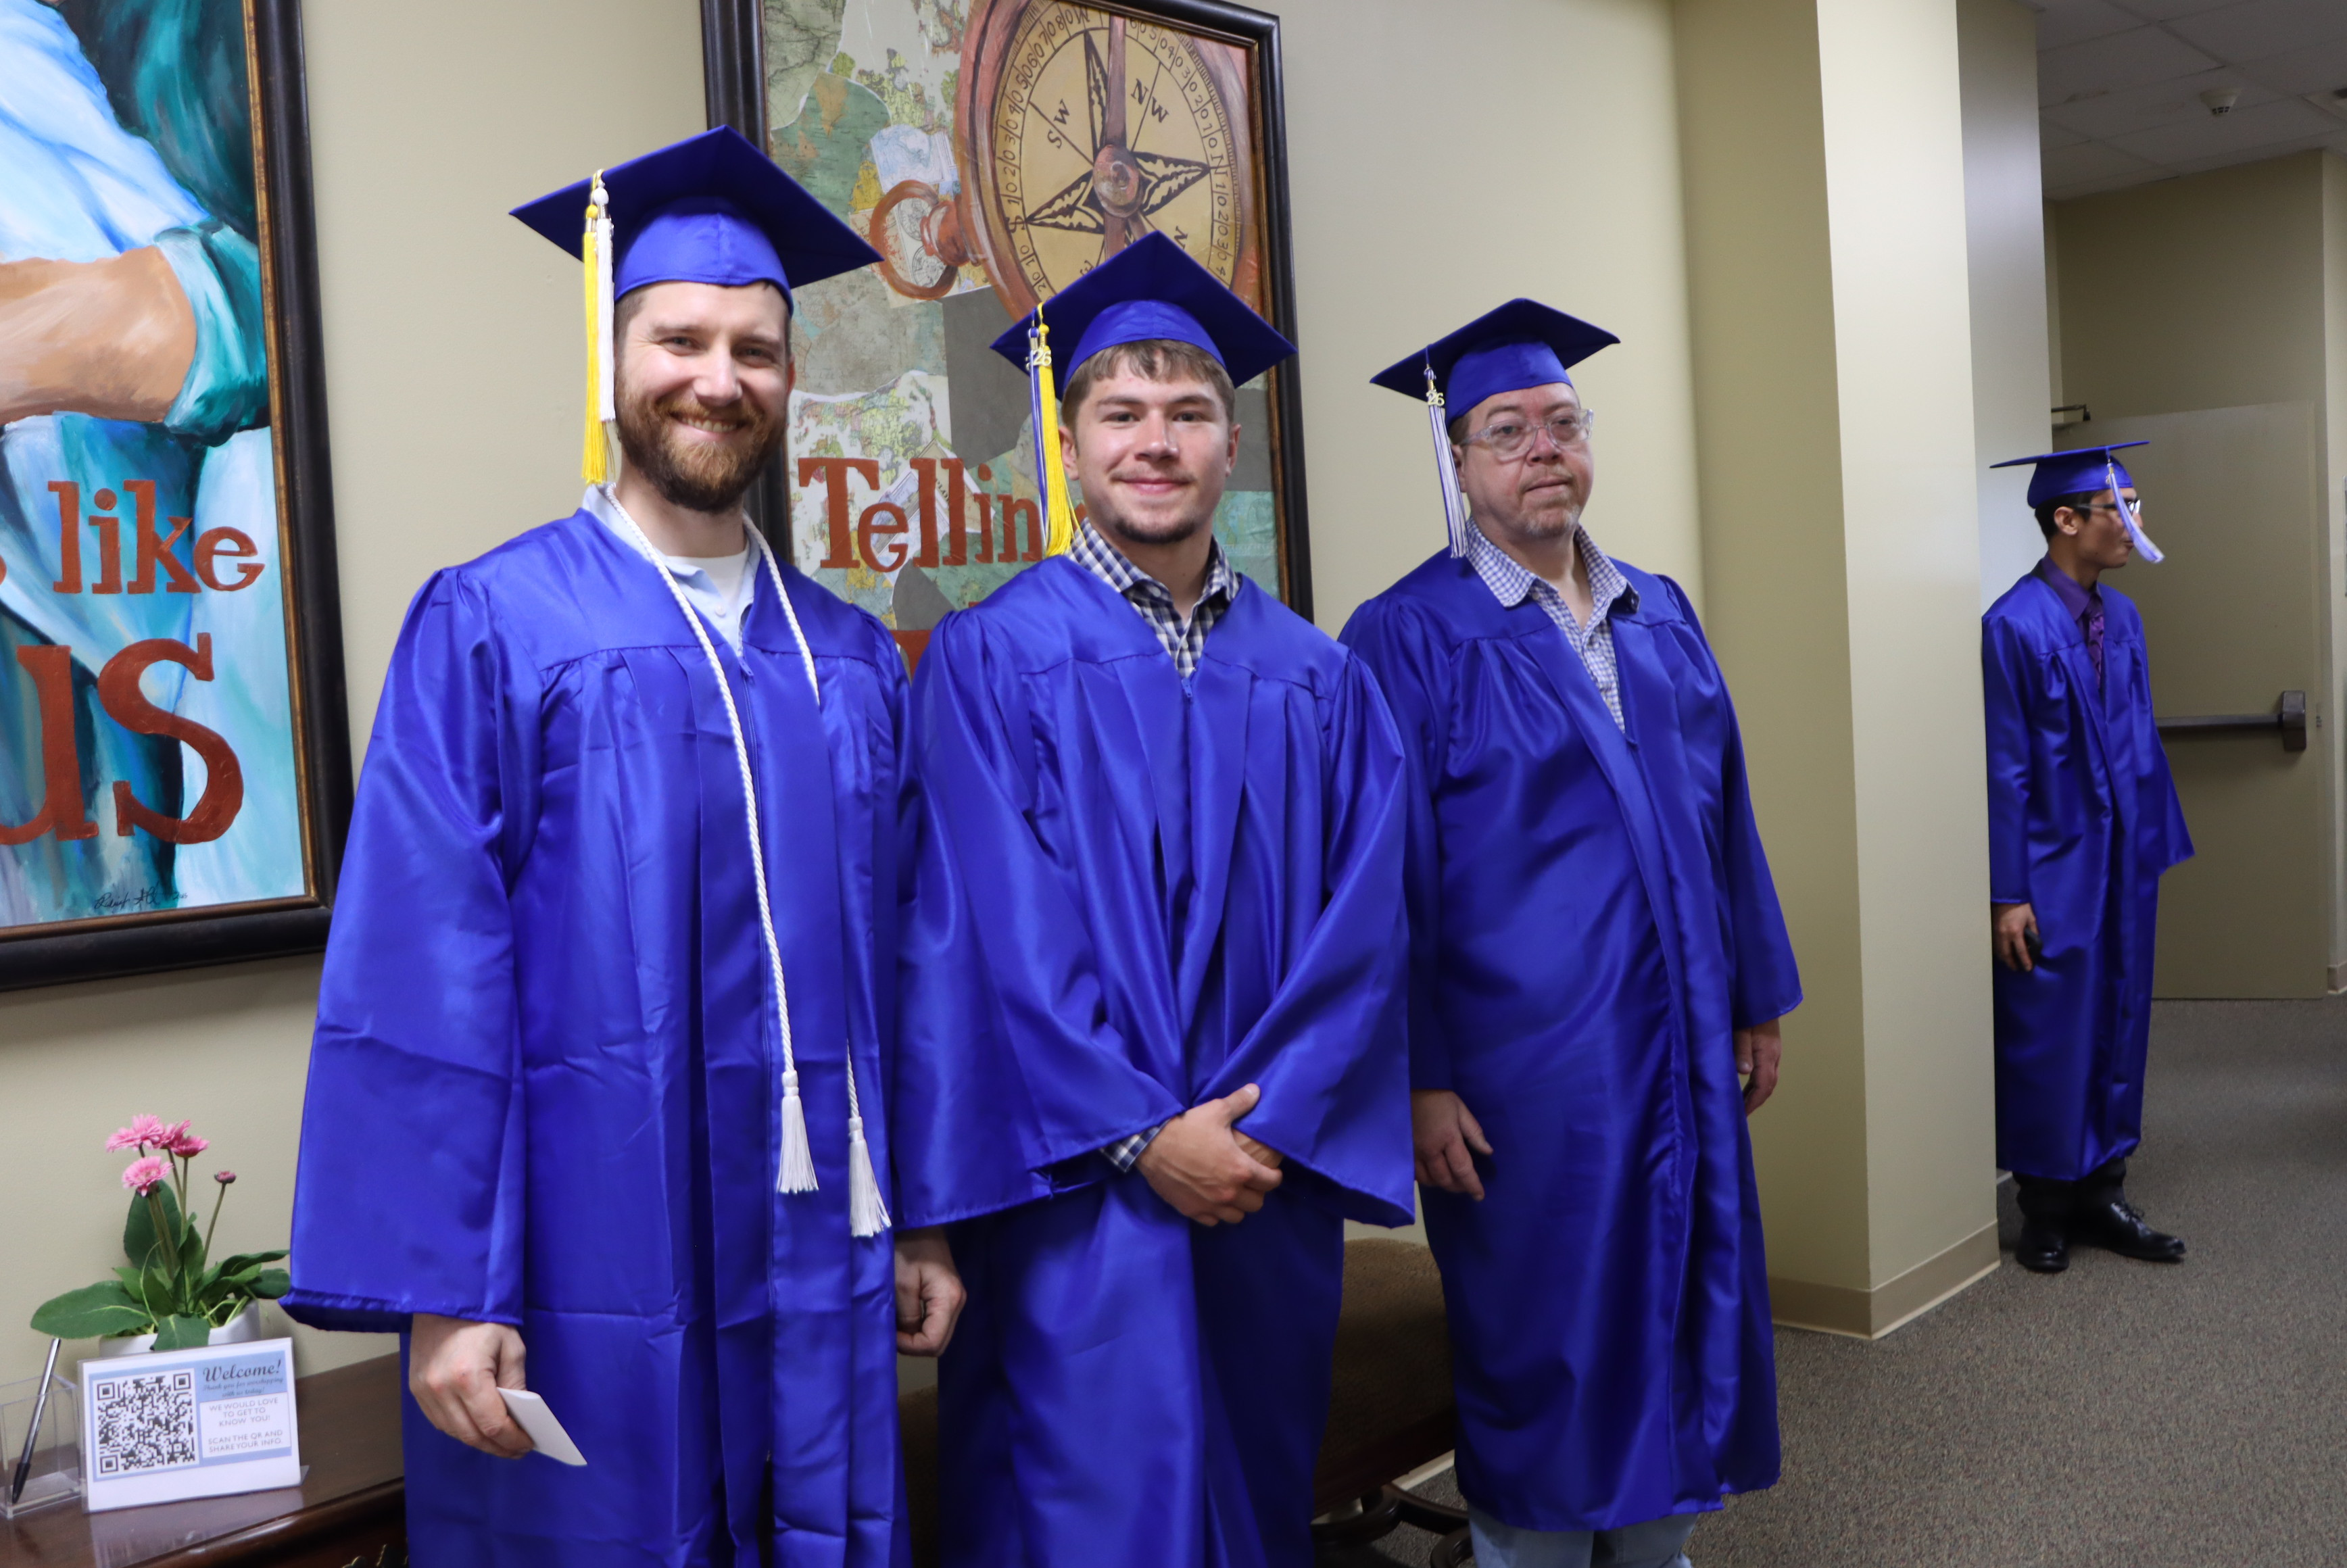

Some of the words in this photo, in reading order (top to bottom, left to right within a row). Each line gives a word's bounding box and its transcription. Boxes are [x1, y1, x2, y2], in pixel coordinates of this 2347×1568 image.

[1033, 348, 1052, 366] 26
[1426, 389, 1445, 407] 26
[798, 457, 1085, 572] Tellin
[47, 479, 265, 595] like
[203, 1358, 282, 1382] Welcome!
[203, 1383, 222, 1391] Thank
[236, 1380, 245, 1388] for
[247, 1377, 283, 1386] worshipping
[245, 1386, 266, 1394] today!
[209, 1404, 222, 1412] WE
[224, 1400, 256, 1410] WOULD
[258, 1397, 279, 1405] LOVE
[237, 1408, 253, 1417] GET
[218, 1417, 247, 1427] KNOW
[250, 1415, 271, 1423] YOU!
[208, 1436, 231, 1445] SCAN
[233, 1434, 249, 1442] THE
[251, 1431, 262, 1440] QR
[264, 1429, 283, 1438] AND
[209, 1444, 236, 1453] SHARE
[236, 1440, 260, 1449] YOUR
